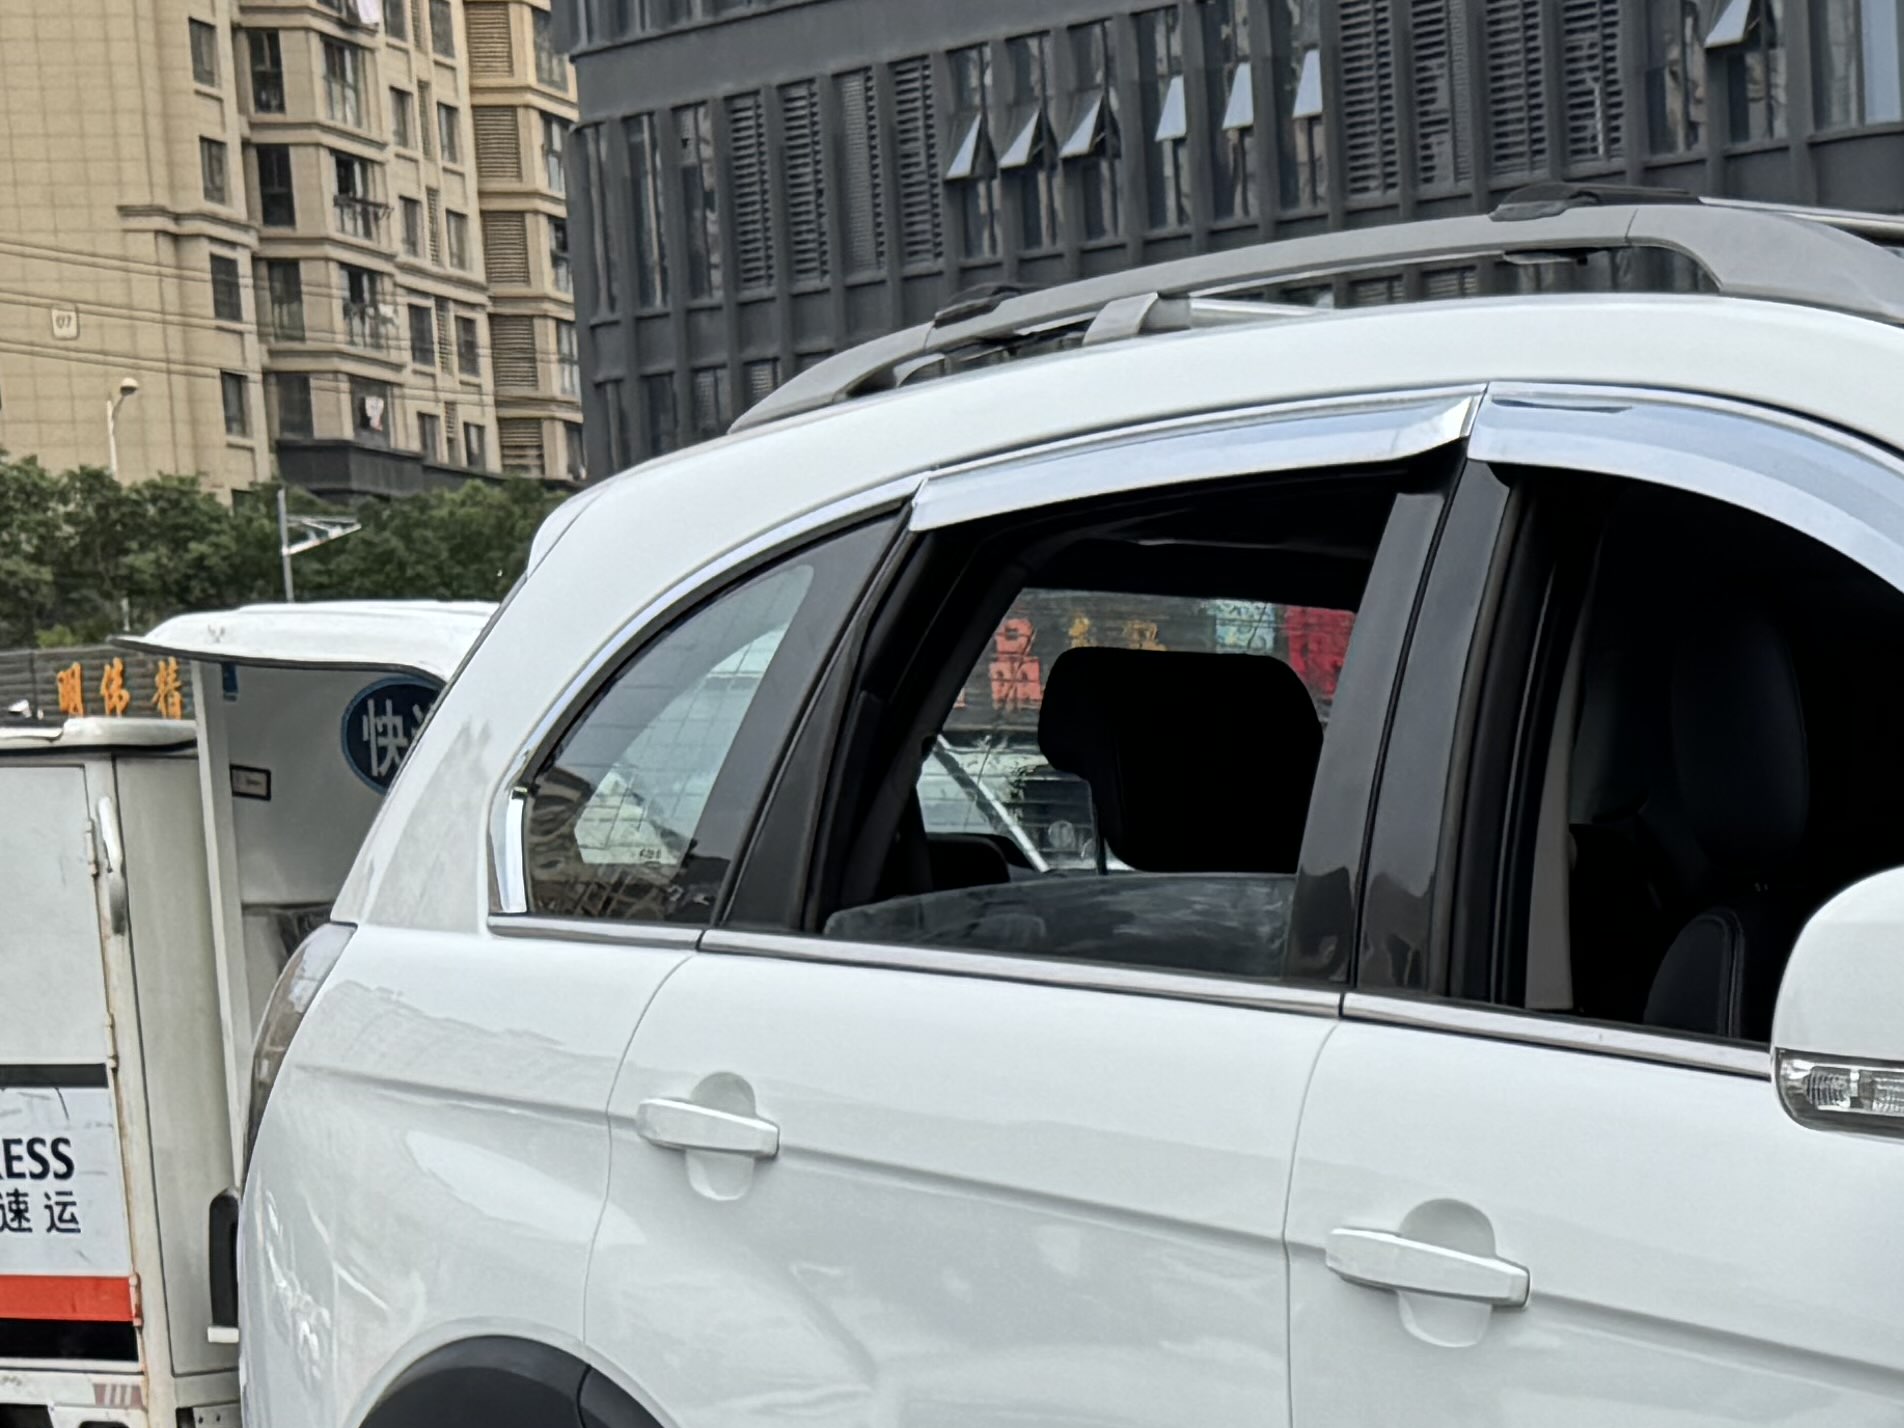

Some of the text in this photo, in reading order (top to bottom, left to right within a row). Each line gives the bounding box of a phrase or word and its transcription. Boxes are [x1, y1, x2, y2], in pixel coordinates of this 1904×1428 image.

[362, 698, 428, 777] 快
[0, 1137, 75, 1181] ESS
[0, 1188, 81, 1233] 速运
